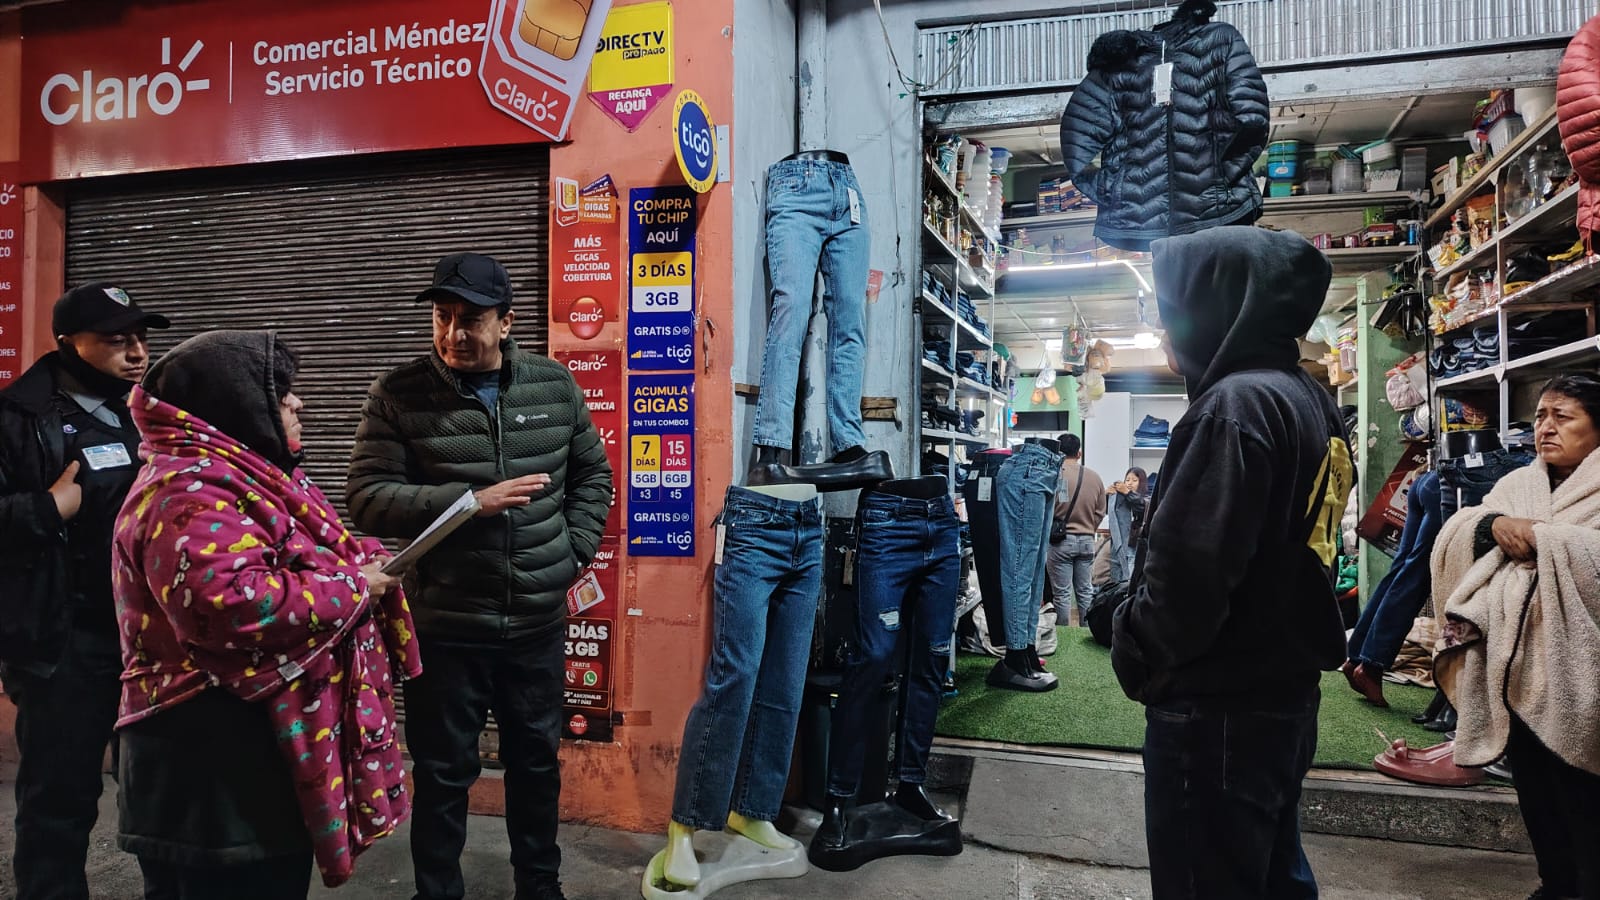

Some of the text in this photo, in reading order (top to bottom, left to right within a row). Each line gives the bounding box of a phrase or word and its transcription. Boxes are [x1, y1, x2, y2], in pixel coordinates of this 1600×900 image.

[253, 20, 486, 66] Comercial Méndez
[595, 30, 664, 53] DIRECTV
[40, 37, 210, 126] Claro
[265, 54, 472, 96] Servicio Técnico
[494, 78, 557, 122] Claro
[608, 88, 652, 101] RECARGA
[616, 98, 646, 114] AQUÍ
[634, 198, 692, 212] COMPRA
[638, 212, 688, 225] TU CHIP
[574, 235, 602, 248] MÁS
[646, 228, 679, 244] AQUÍ
[574, 254, 600, 262] GIGAS
[564, 262, 610, 272] VELOCIDAD
[638, 260, 686, 277] 3 DÍAS
[562, 272, 612, 282] COBERTURA
[645, 292, 679, 306] 3GB
[570, 308, 602, 322] Claro
[634, 326, 671, 336] GRATIS
[568, 355, 607, 371] Claro
[592, 389, 603, 397] LA
[634, 386, 688, 396] ACUMULA
[584, 402, 615, 410] IENCIA
[634, 398, 688, 413] GIGAS
[641, 441, 650, 455] 7
[667, 441, 684, 455] 15
[636, 456, 656, 466] DÍAS
[666, 456, 687, 466] DÍAS
[635, 474, 656, 483] 5GB
[665, 474, 687, 483] 6GB
[640, 489, 651, 499] $3
[670, 489, 682, 499] $5
[634, 512, 671, 522] GRATIS
[569, 620, 608, 640] DÍAS
